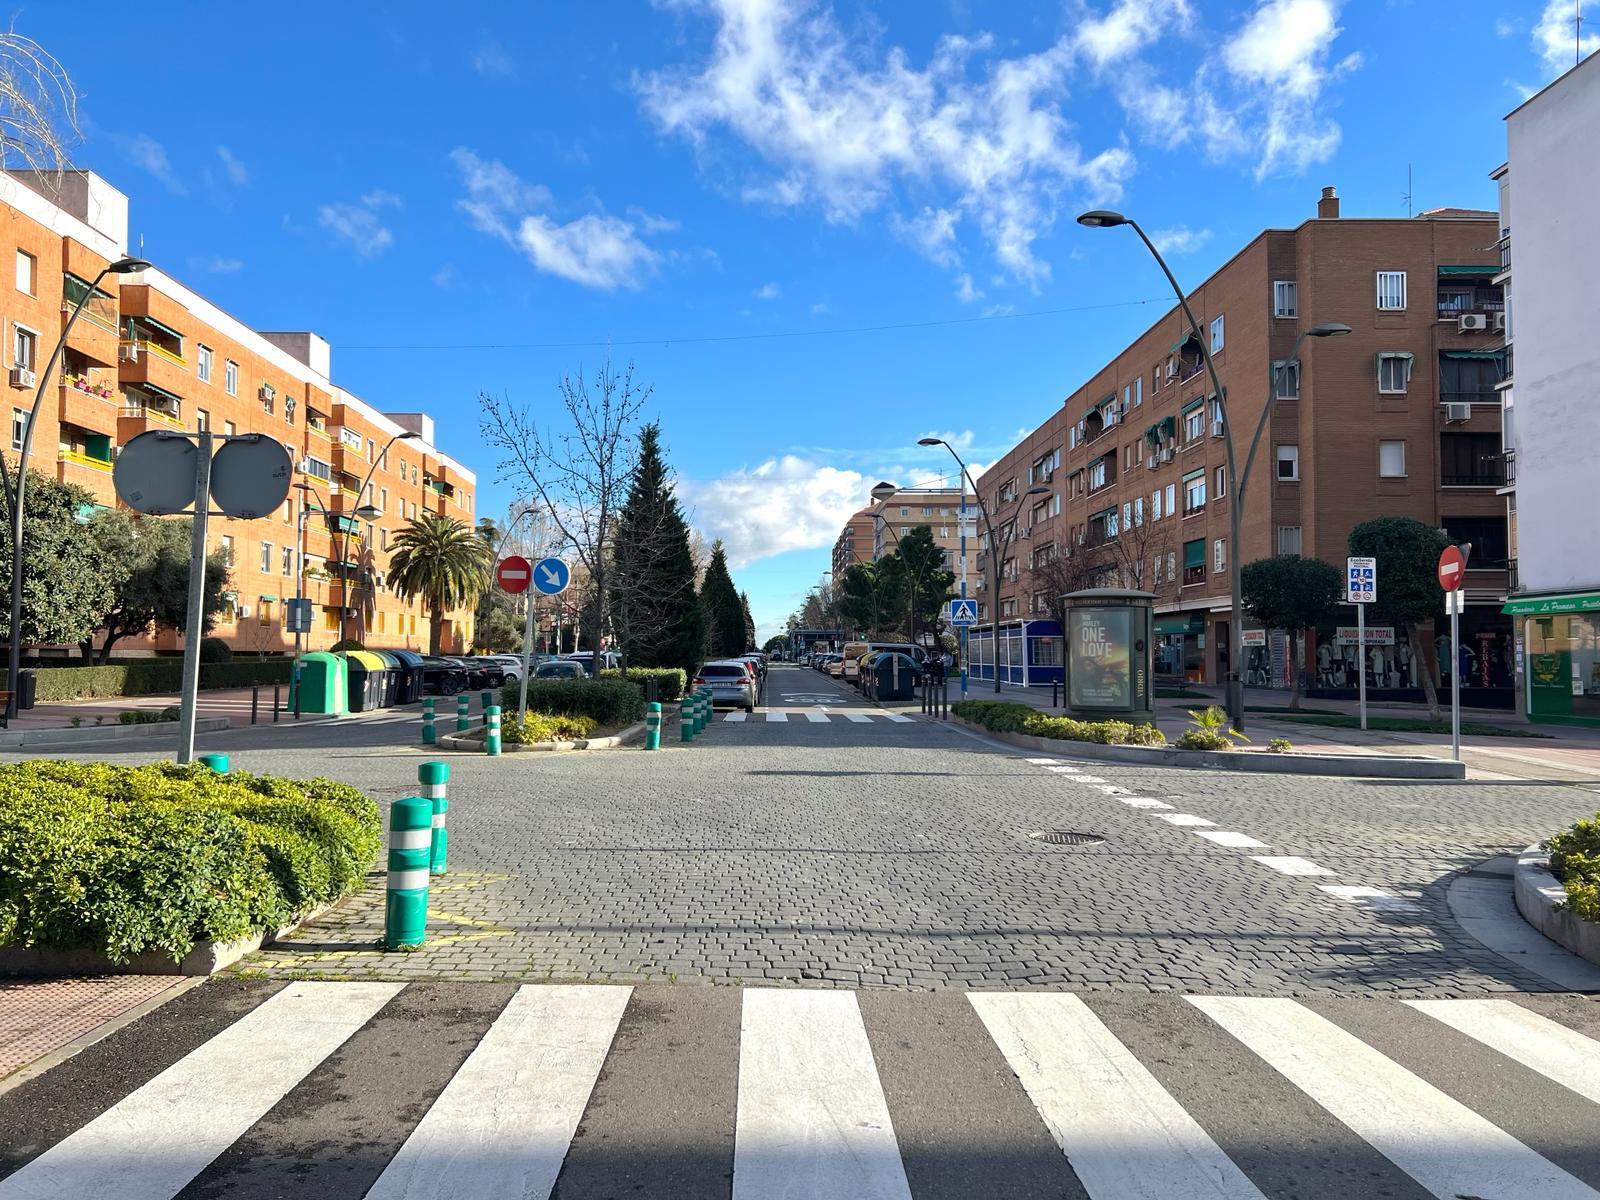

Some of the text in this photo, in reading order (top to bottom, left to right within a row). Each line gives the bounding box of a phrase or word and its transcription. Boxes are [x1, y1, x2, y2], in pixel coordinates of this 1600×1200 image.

[1082, 627, 1106, 642] ONE
[1375, 629, 1392, 638] TOTAL
[1082, 642, 1113, 657] LOVE
[1481, 640, 1489, 688] REBAJAS
